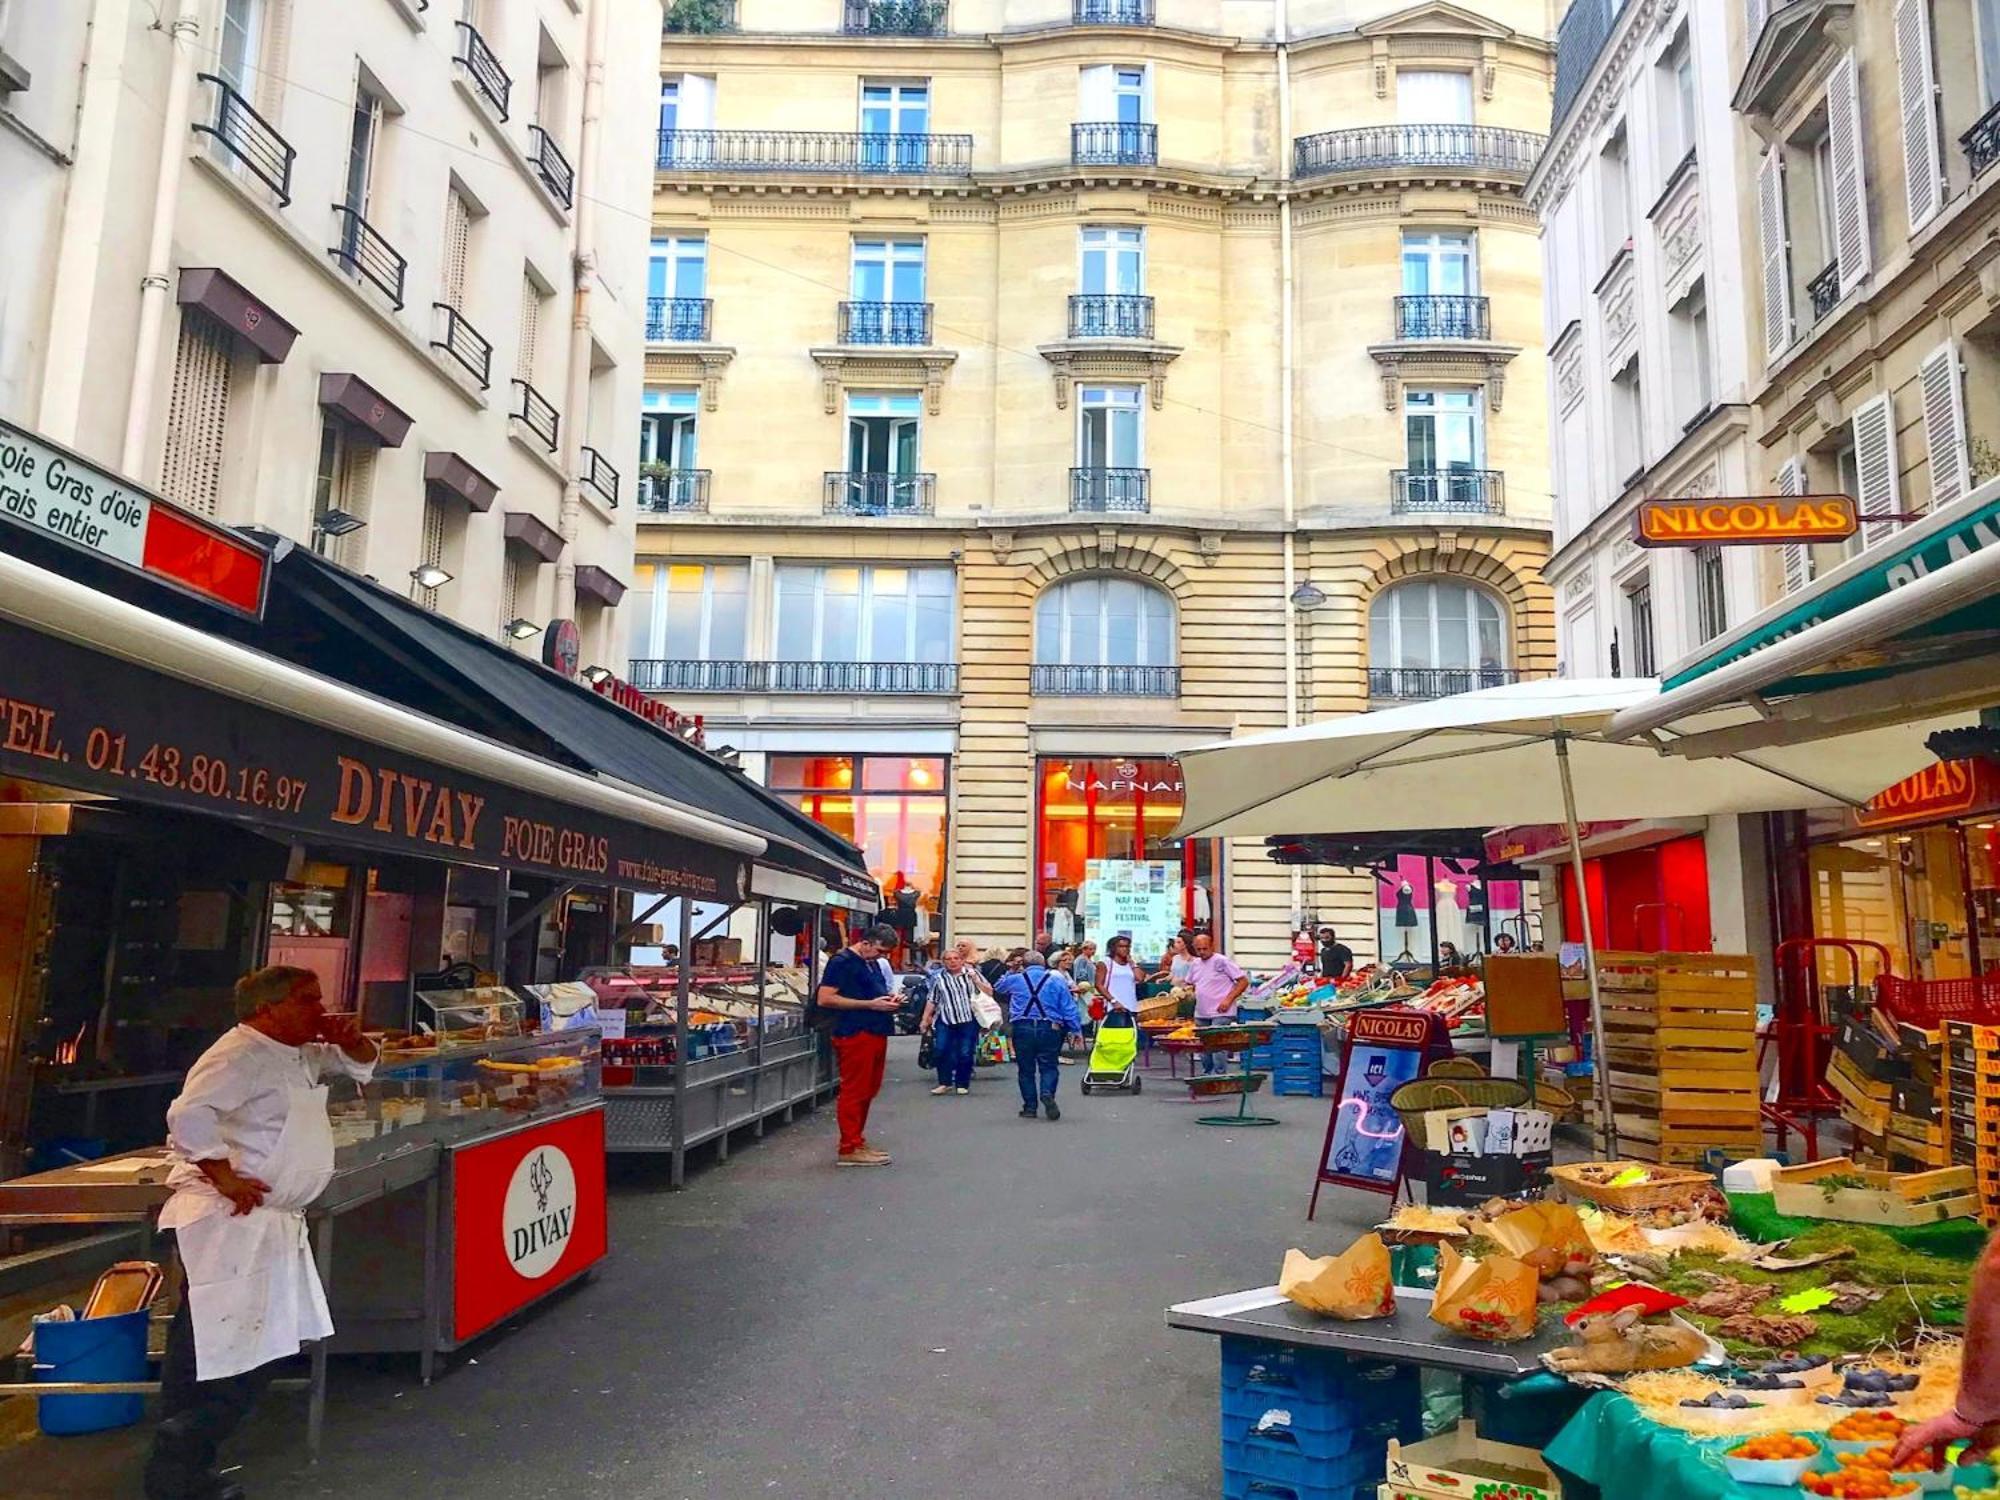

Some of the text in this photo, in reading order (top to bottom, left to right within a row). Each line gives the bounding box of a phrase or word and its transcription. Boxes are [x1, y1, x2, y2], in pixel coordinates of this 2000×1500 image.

[0, 469, 108, 547] rais entier
[46, 458, 94, 506] Gras
[100, 490, 143, 528] d'oie
[1649, 502, 1847, 533] NICOLAS
[0, 699, 69, 763] EL.
[86, 726, 307, 813] 01.43.80.16.97
[330, 755, 484, 850] DIVAY
[502, 816, 554, 865] FOIE
[558, 828, 608, 874] GRAS
[1358, 1019, 1422, 1039] NICOLAS
[512, 1204, 572, 1262] DIVAY
